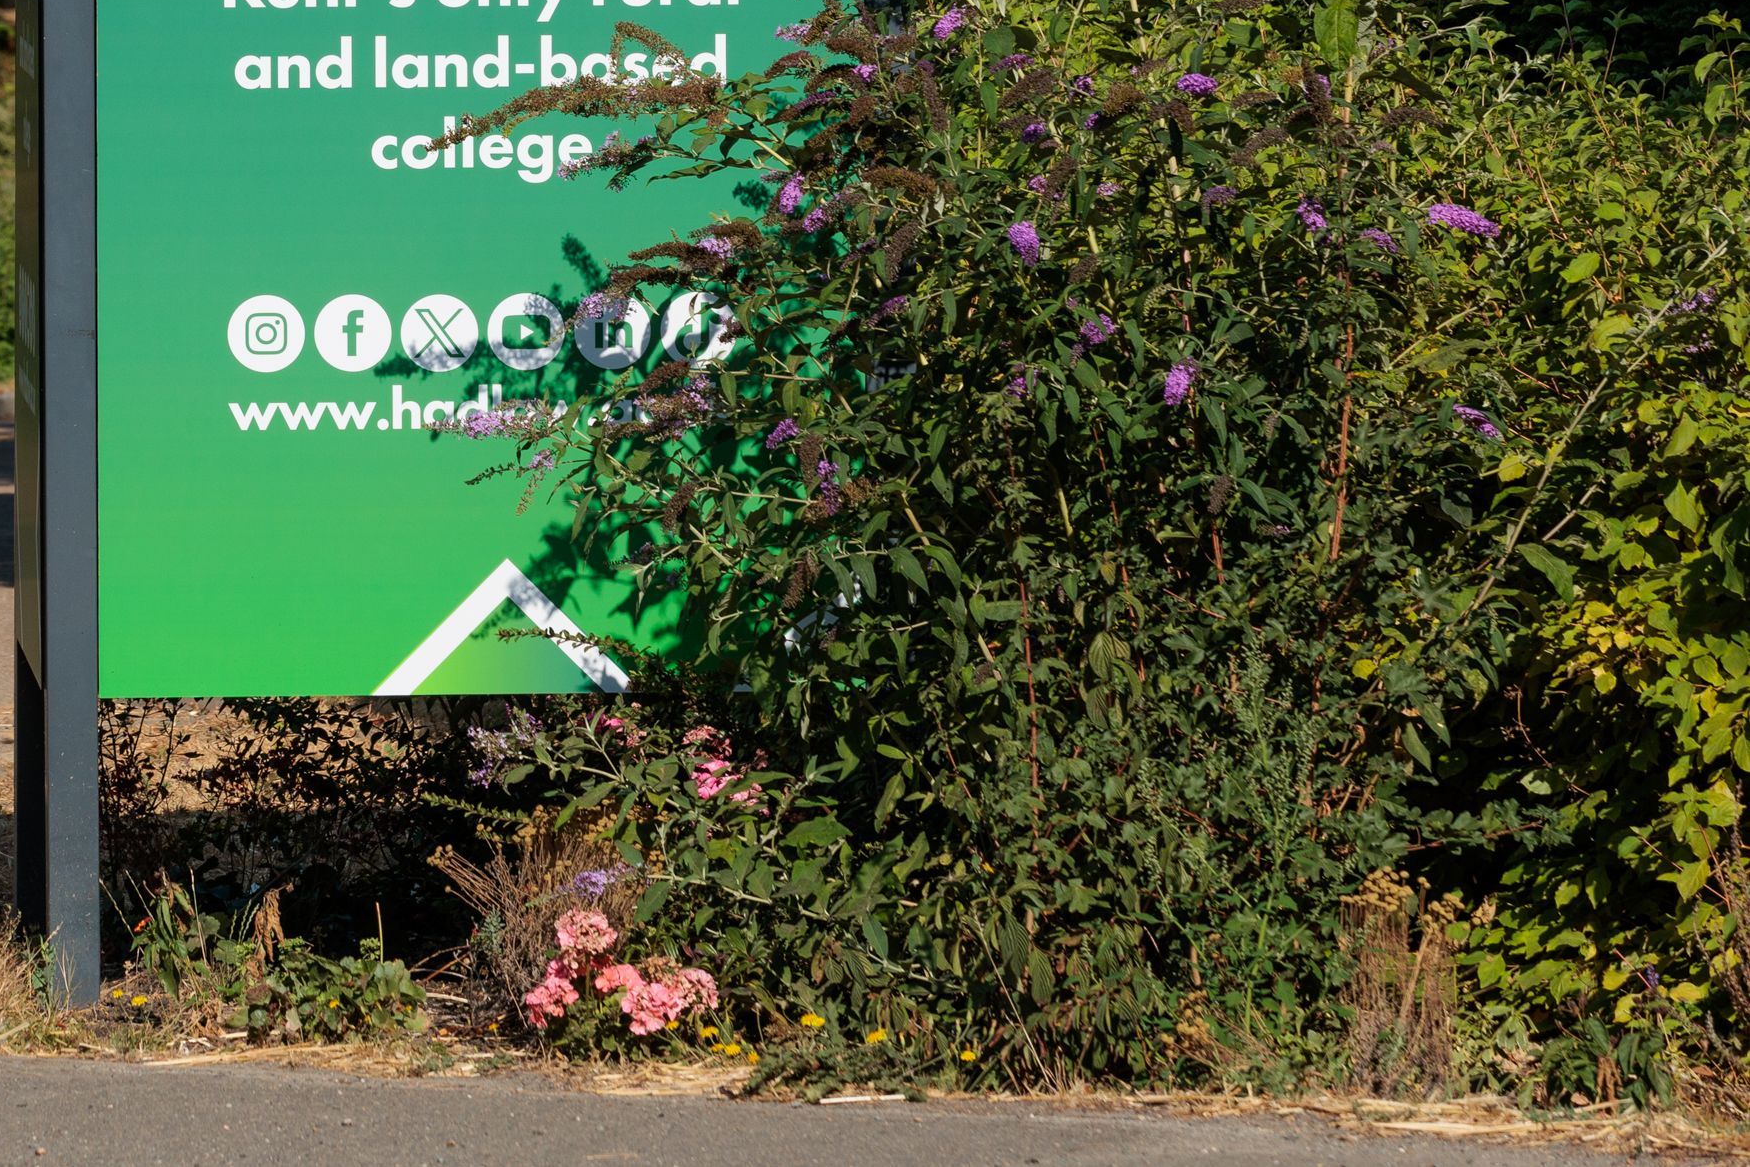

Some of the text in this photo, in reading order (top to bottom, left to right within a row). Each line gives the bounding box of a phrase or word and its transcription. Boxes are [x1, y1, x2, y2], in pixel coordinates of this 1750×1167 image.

[234, 34, 727, 90] and land-based
[371, 115, 593, 184] college
